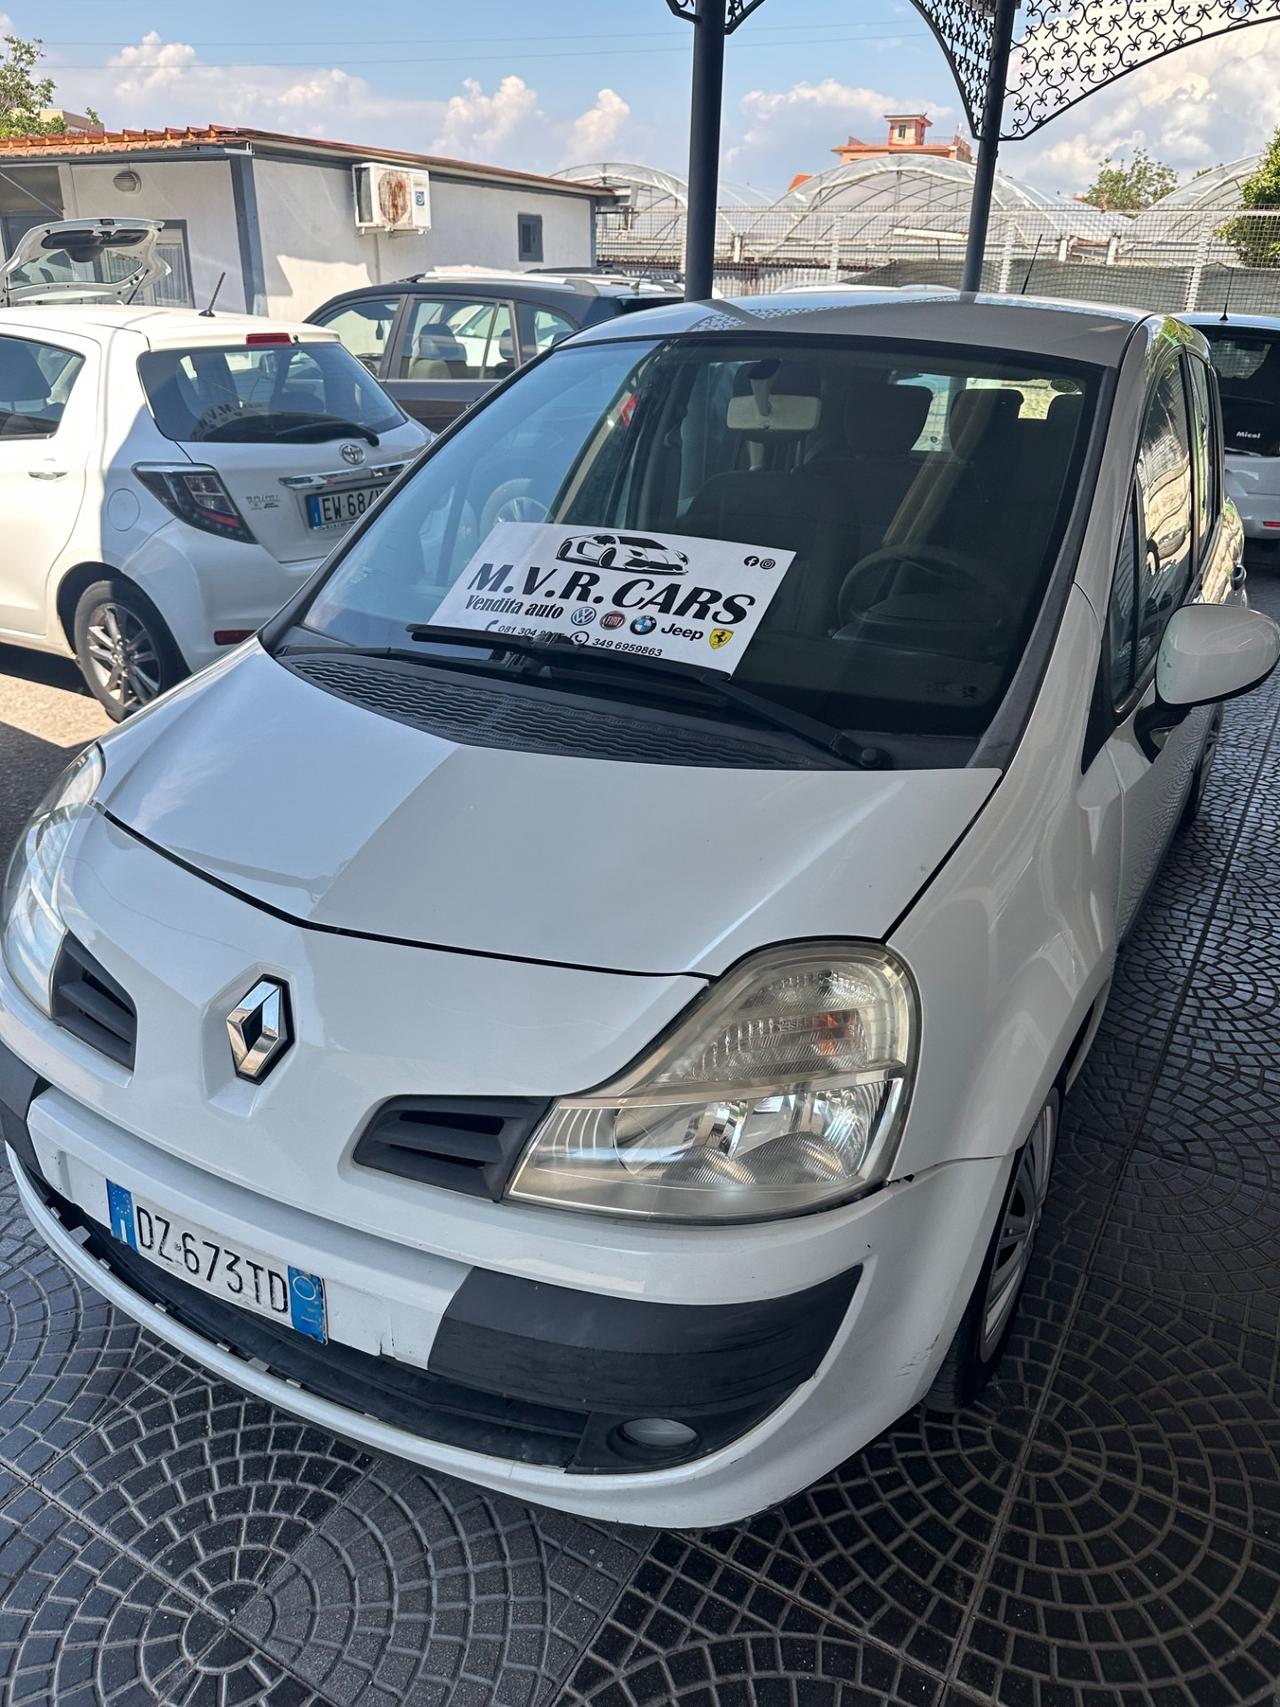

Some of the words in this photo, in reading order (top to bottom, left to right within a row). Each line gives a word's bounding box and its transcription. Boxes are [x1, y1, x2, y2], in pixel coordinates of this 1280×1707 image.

[465, 594, 524, 615] Vendita
[524, 602, 564, 619] auto
[498, 625, 516, 634] 081
[518, 627, 538, 637] 304
[661, 623, 704, 641] Jeep
[592, 637, 613, 648] 349
[614, 641, 663, 657] 6959863
